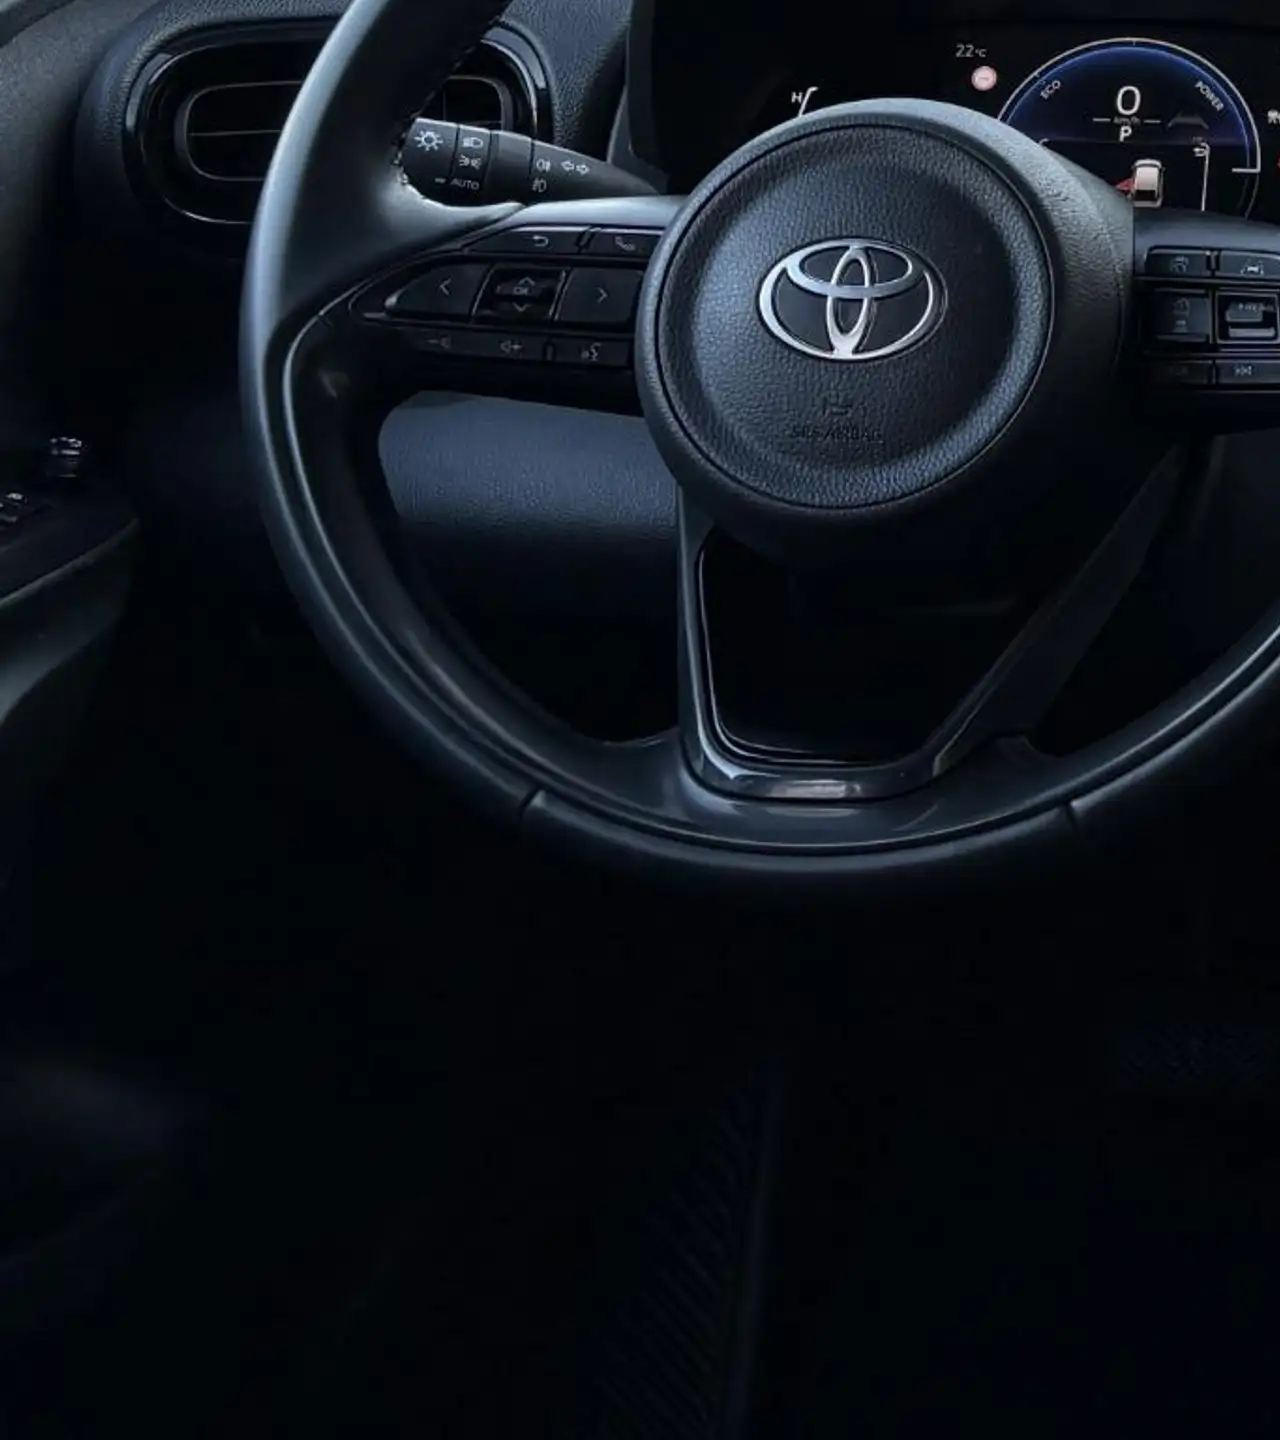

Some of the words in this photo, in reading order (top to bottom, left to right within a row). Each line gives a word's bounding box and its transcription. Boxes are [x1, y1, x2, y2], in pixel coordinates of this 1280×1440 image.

[1116, 85, 1141, 115] 0
[1120, 125, 1133, 142] P
[451, 178, 480, 191] AUTO
